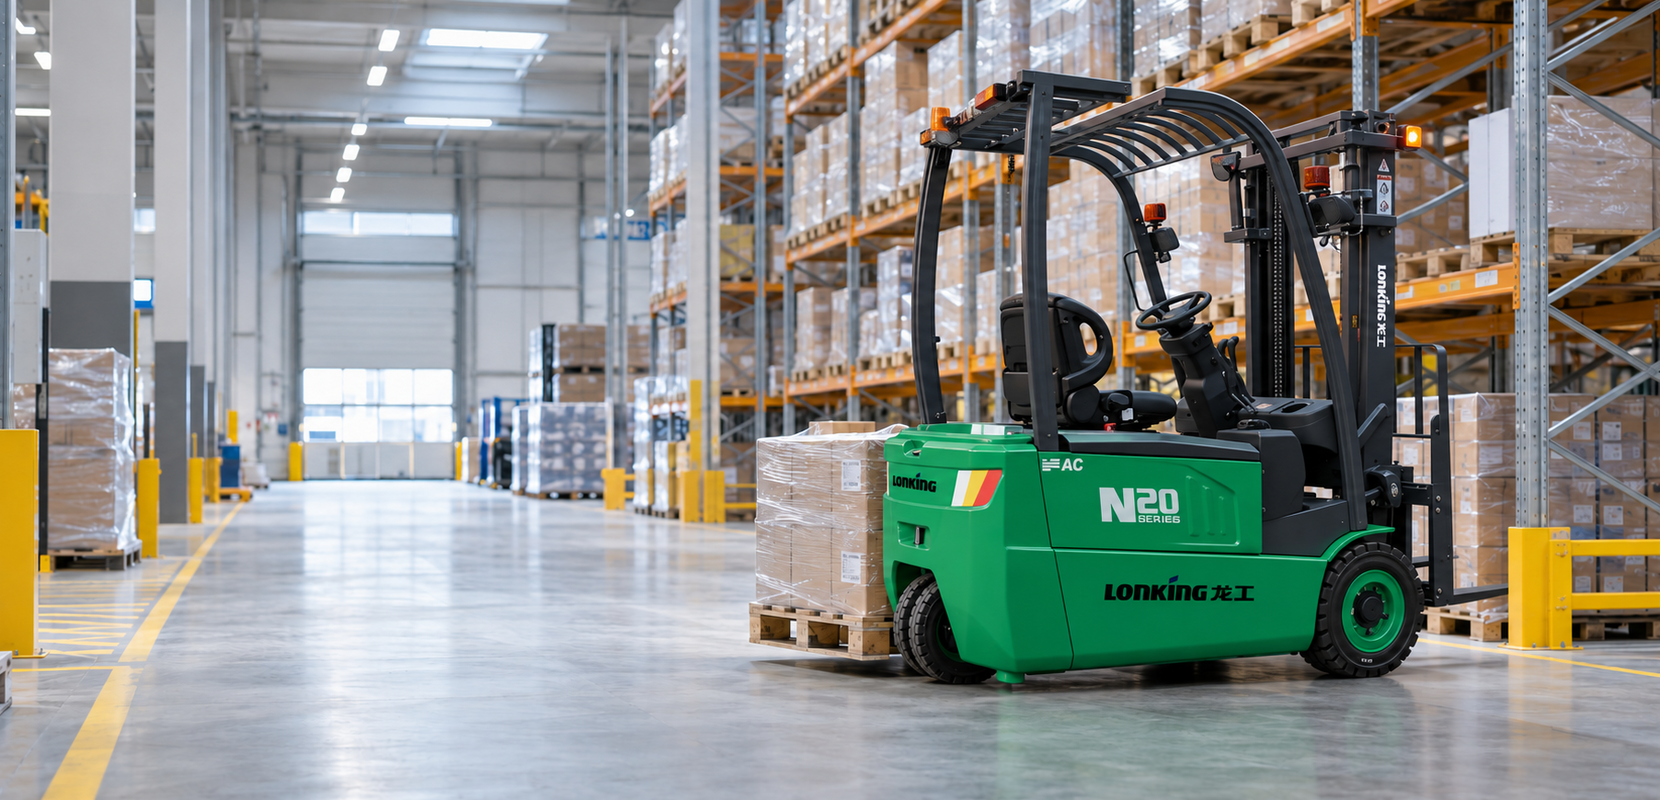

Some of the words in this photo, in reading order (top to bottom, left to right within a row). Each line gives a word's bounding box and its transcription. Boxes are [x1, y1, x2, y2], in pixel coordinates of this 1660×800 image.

[1061, 458, 1083, 472] AC
[1138, 515, 1181, 524] SERIES
[1210, 585, 1255, 601] 龙工
